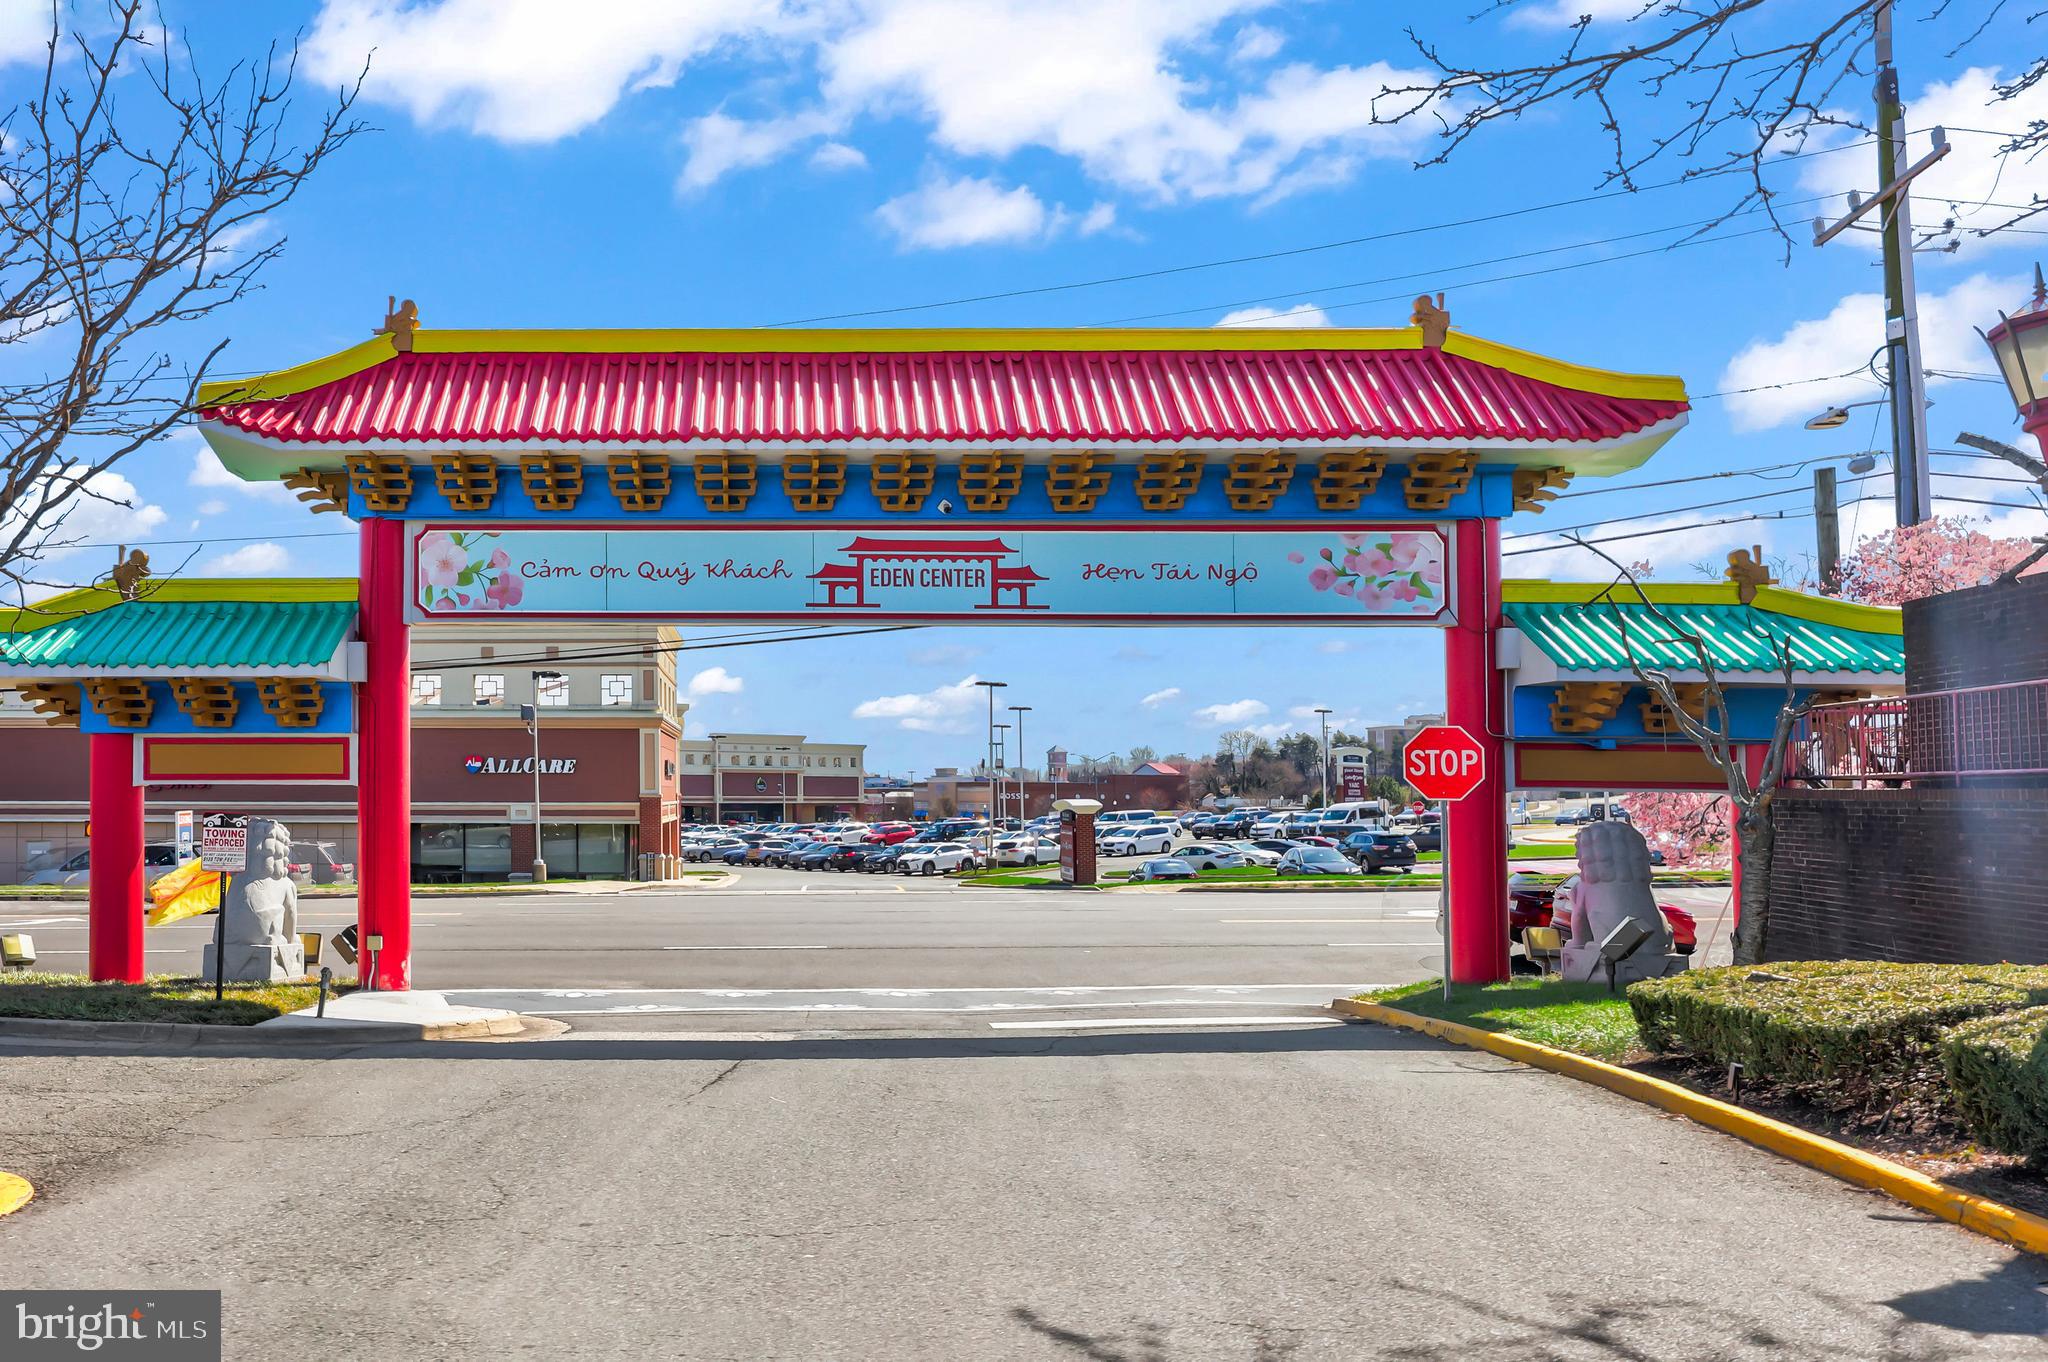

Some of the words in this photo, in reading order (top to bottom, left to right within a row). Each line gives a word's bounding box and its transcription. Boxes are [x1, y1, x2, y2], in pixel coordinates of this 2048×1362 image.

[520, 558, 581, 579] Cảm
[637, 561, 696, 586] Quý
[703, 558, 793, 579] Khách
[870, 568, 915, 587] EDEN
[919, 568, 986, 588] CENTER
[1081, 562, 1145, 582] Hẹn
[1151, 562, 1200, 581] Tái
[1207, 561, 1259, 587] Ngộ
[1409, 749, 1479, 777] STOP
[204, 838, 245, 847] ENFORCED
[205, 829, 245, 838] TOWING
